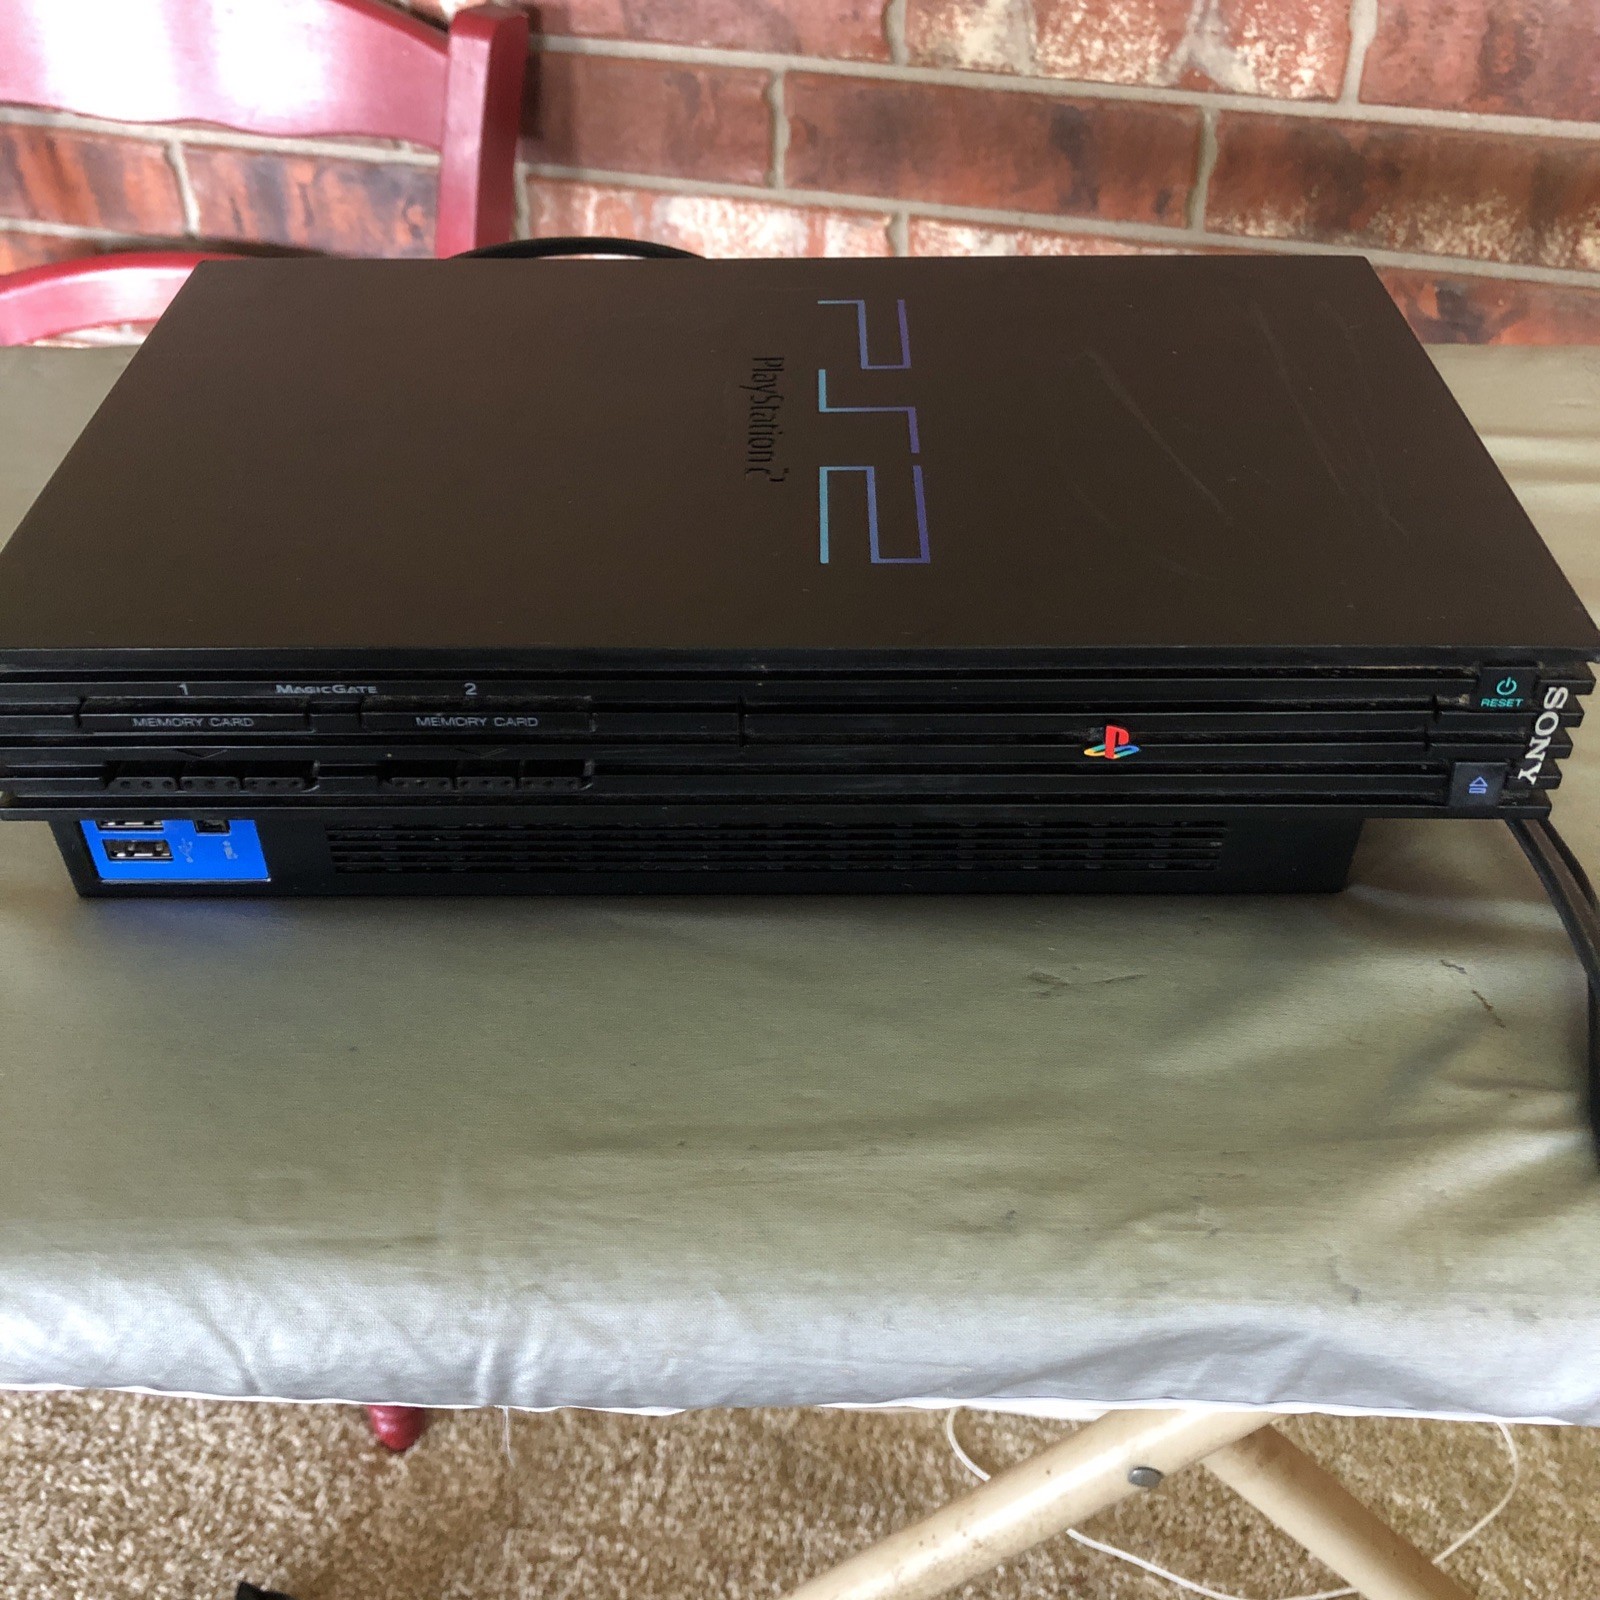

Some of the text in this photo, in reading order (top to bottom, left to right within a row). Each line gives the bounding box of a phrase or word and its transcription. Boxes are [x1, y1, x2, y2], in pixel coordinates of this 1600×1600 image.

[177, 682, 190, 696] 1
[464, 682, 478, 696] 2
[1481, 698, 1523, 707] RESET
[132, 716, 255, 728] MEMORY CARD
[415, 716, 539, 728] MEMORY CARD
[1518, 687, 1568, 785] SONY
